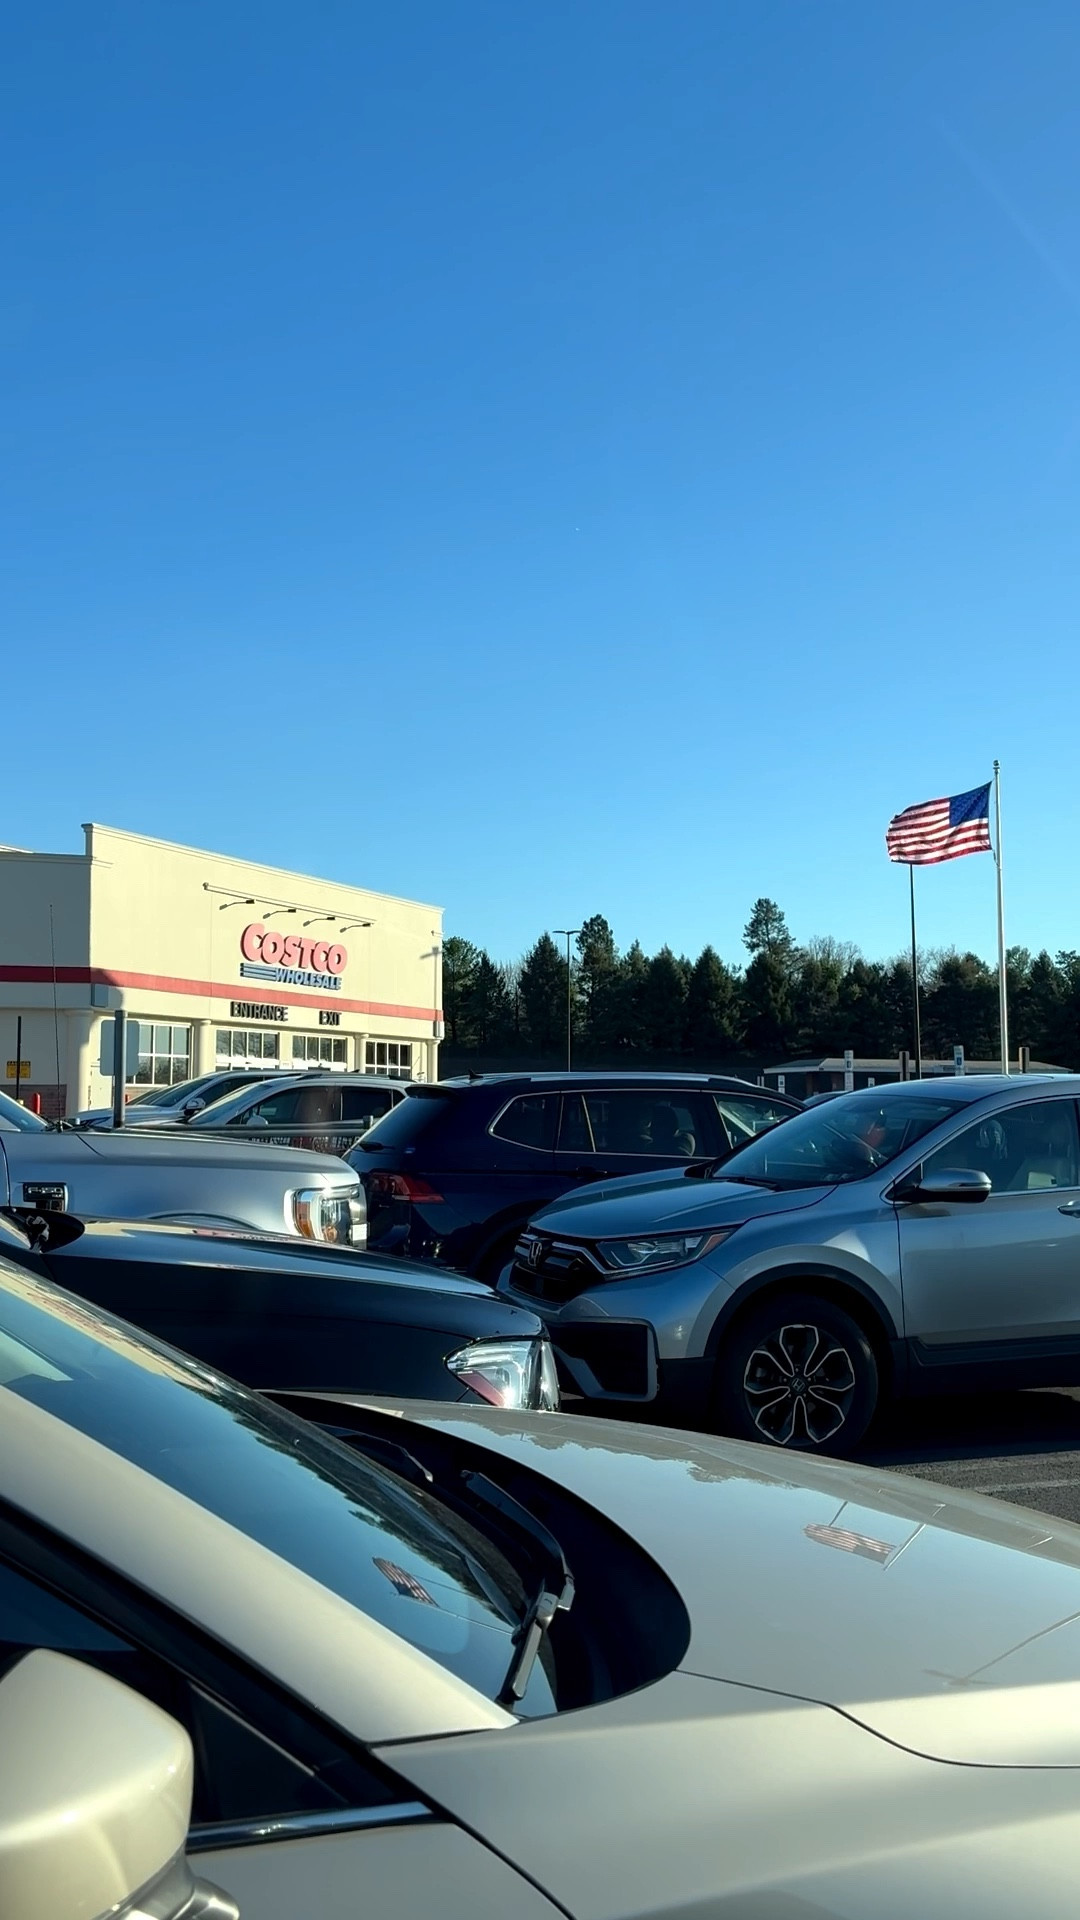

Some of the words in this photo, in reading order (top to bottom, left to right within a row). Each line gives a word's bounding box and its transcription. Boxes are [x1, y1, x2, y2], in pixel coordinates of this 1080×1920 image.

[240, 922, 348, 975] COSTCO
[275, 967, 342, 990] WHOLESALE
[230, 1001, 288, 1022] ENTRANCE
[319, 1010, 341, 1026] EXIT
